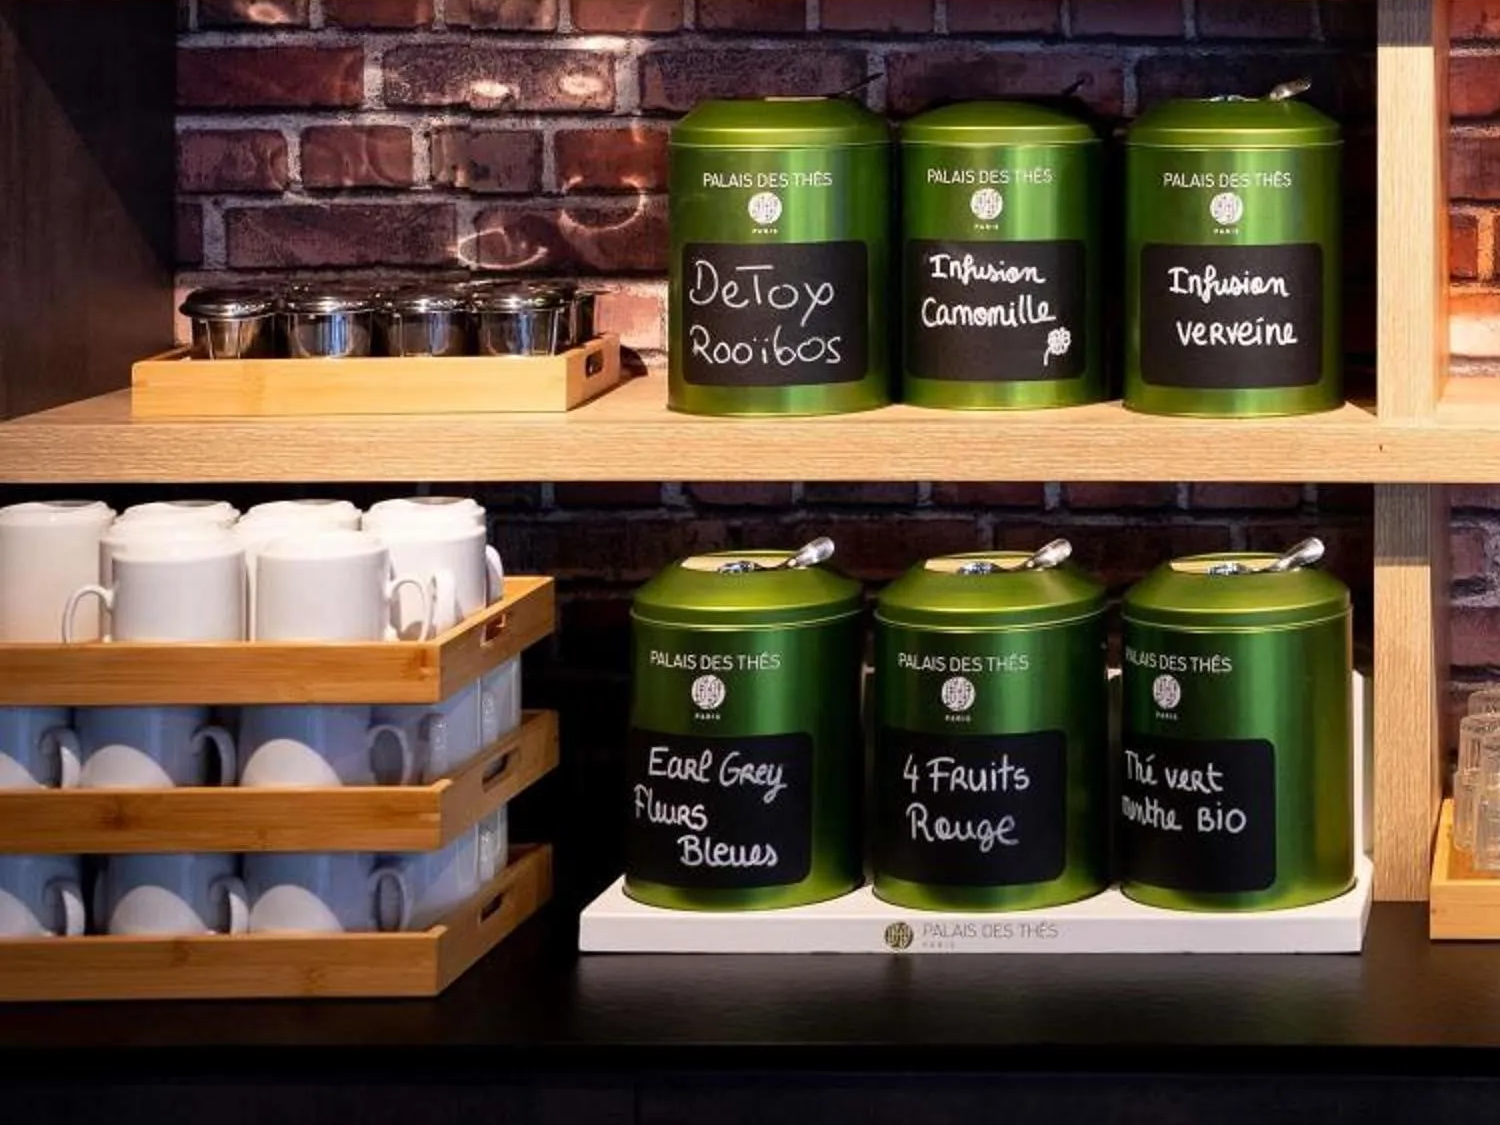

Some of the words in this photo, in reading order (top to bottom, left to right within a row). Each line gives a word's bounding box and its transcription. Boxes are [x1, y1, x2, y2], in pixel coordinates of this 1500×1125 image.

[703, 173, 752, 188] PALAIS
[757, 173, 789, 188] DES
[927, 169, 976, 184] PALAIS
[979, 170, 1010, 184] DES
[1163, 173, 1215, 188] PALAIS
[1219, 173, 1250, 188] DES
[929, 253, 1046, 286] Infusion
[1167, 264, 1291, 304] Infusion
[921, 294, 1057, 328] Camomille
[650, 650, 697, 670] PALAIS
[700, 654, 733, 671] DES
[898, 652, 946, 672] PALAIS
[949, 656, 983, 672] DES
[1159, 654, 1187, 672] DES
[648, 746, 711, 783] Earl
[719, 750, 788, 804] Grey
[903, 753, 920, 793] 4
[926, 752, 1031, 793] Fruits
[1125, 748, 1158, 786] Thé
[1165, 762, 1224, 794] vert
[906, 802, 1020, 853] Rouge
[677, 833, 778, 868] Bleues
[923, 922, 979, 938] PALAIS
[981, 922, 1013, 938] DES
